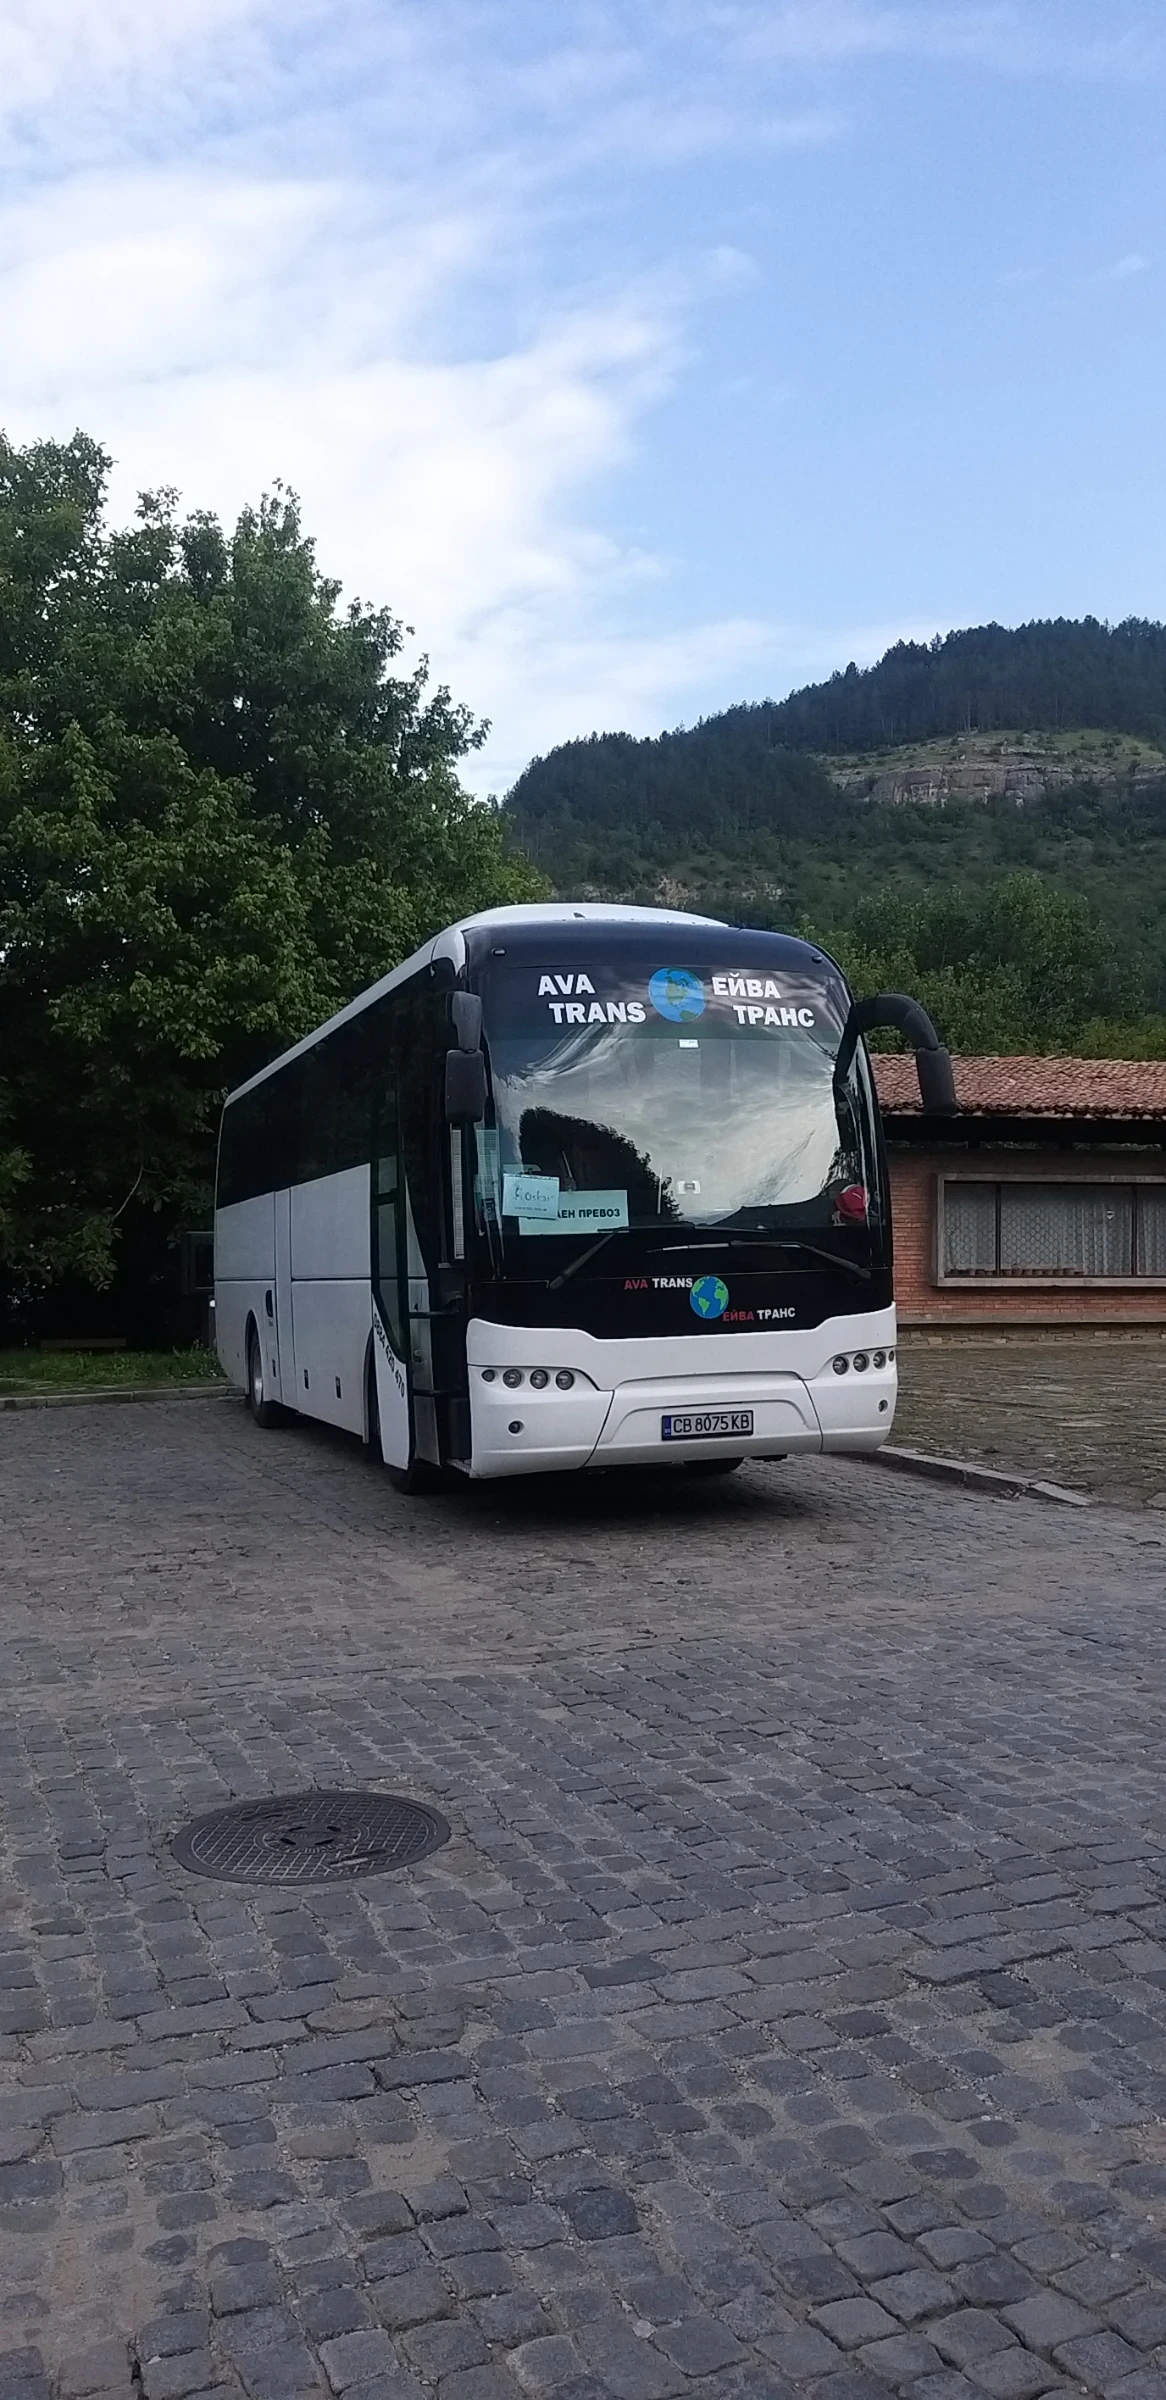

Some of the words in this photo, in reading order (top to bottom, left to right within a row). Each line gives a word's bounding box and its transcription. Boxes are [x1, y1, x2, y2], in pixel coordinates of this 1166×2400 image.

[538, 974, 596, 996] AVA
[711, 973, 781, 999] ЕЙВА
[548, 1001, 647, 1024] TRANS
[733, 1005, 815, 1028] ТРАНС
[578, 1208, 621, 1219] ПРЕВОЗ
[624, 1279, 648, 1290] AVA
[651, 1277, 693, 1289] TRANS
[722, 1310, 754, 1322] ЕЙВА
[757, 1307, 796, 1320] ТРАНС
[673, 1418, 692, 1433] CB
[695, 1415, 729, 1431] 8075
[731, 1414, 750, 1430] KB
